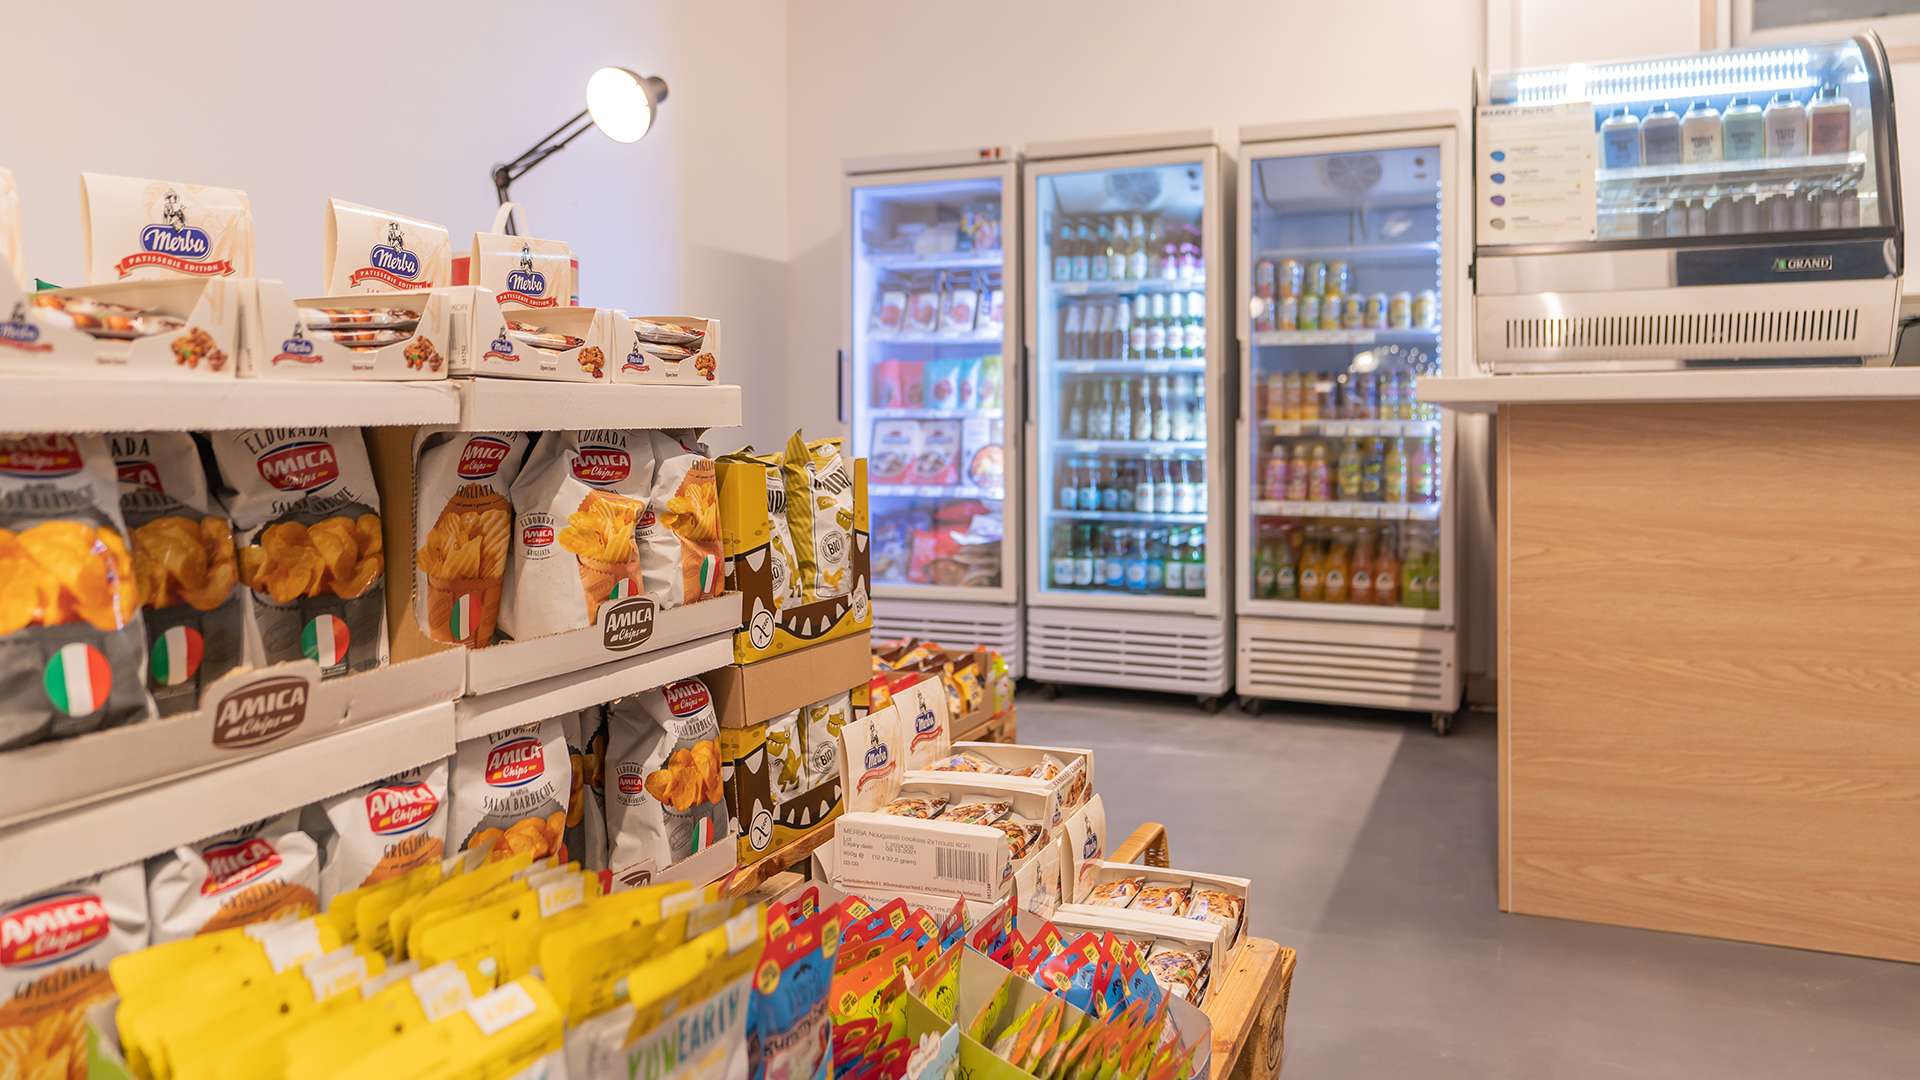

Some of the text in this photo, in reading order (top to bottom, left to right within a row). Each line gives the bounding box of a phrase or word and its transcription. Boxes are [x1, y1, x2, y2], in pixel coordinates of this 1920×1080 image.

[144, 228, 206, 253] Merba
[128, 255, 219, 273] PATISSERIE EDITION
[373, 249, 416, 273] Merba
[1787, 258, 1829, 270] GRAND
[360, 270, 397, 284] PATISSERIE
[509, 273, 543, 291] Merba
[500, 293, 529, 303] PATISSERIE
[462, 445, 506, 461] AMICA
[573, 455, 629, 467] AMICA
[262, 449, 334, 480] AMICA
[469, 460, 487, 473] Chips
[591, 466, 615, 479] Chips
[284, 472, 317, 487] Chips
[456, 484, 495, 499] GRIGLIATA
[520, 516, 554, 527] ELDORADA
[525, 530, 553, 538] AMICA
[827, 540, 841, 555] BIO
[606, 607, 653, 633] AMICA
[618, 627, 640, 643] Chips
[666, 683, 705, 704] AMICA
[217, 686, 305, 728] AMICA
[680, 698, 698, 709] Chips
[241, 715, 282, 736] Chips
[488, 744, 542, 771] AMICA
[820, 749, 832, 766] BIO
[502, 765, 529, 779] Chips
[370, 787, 433, 819] AMICA
[482, 780, 555, 812] SALSA BARBECUE
[391, 806, 422, 824] Chips
[843, 828, 867, 836] MERBA
[1, 900, 104, 949] AMICA
